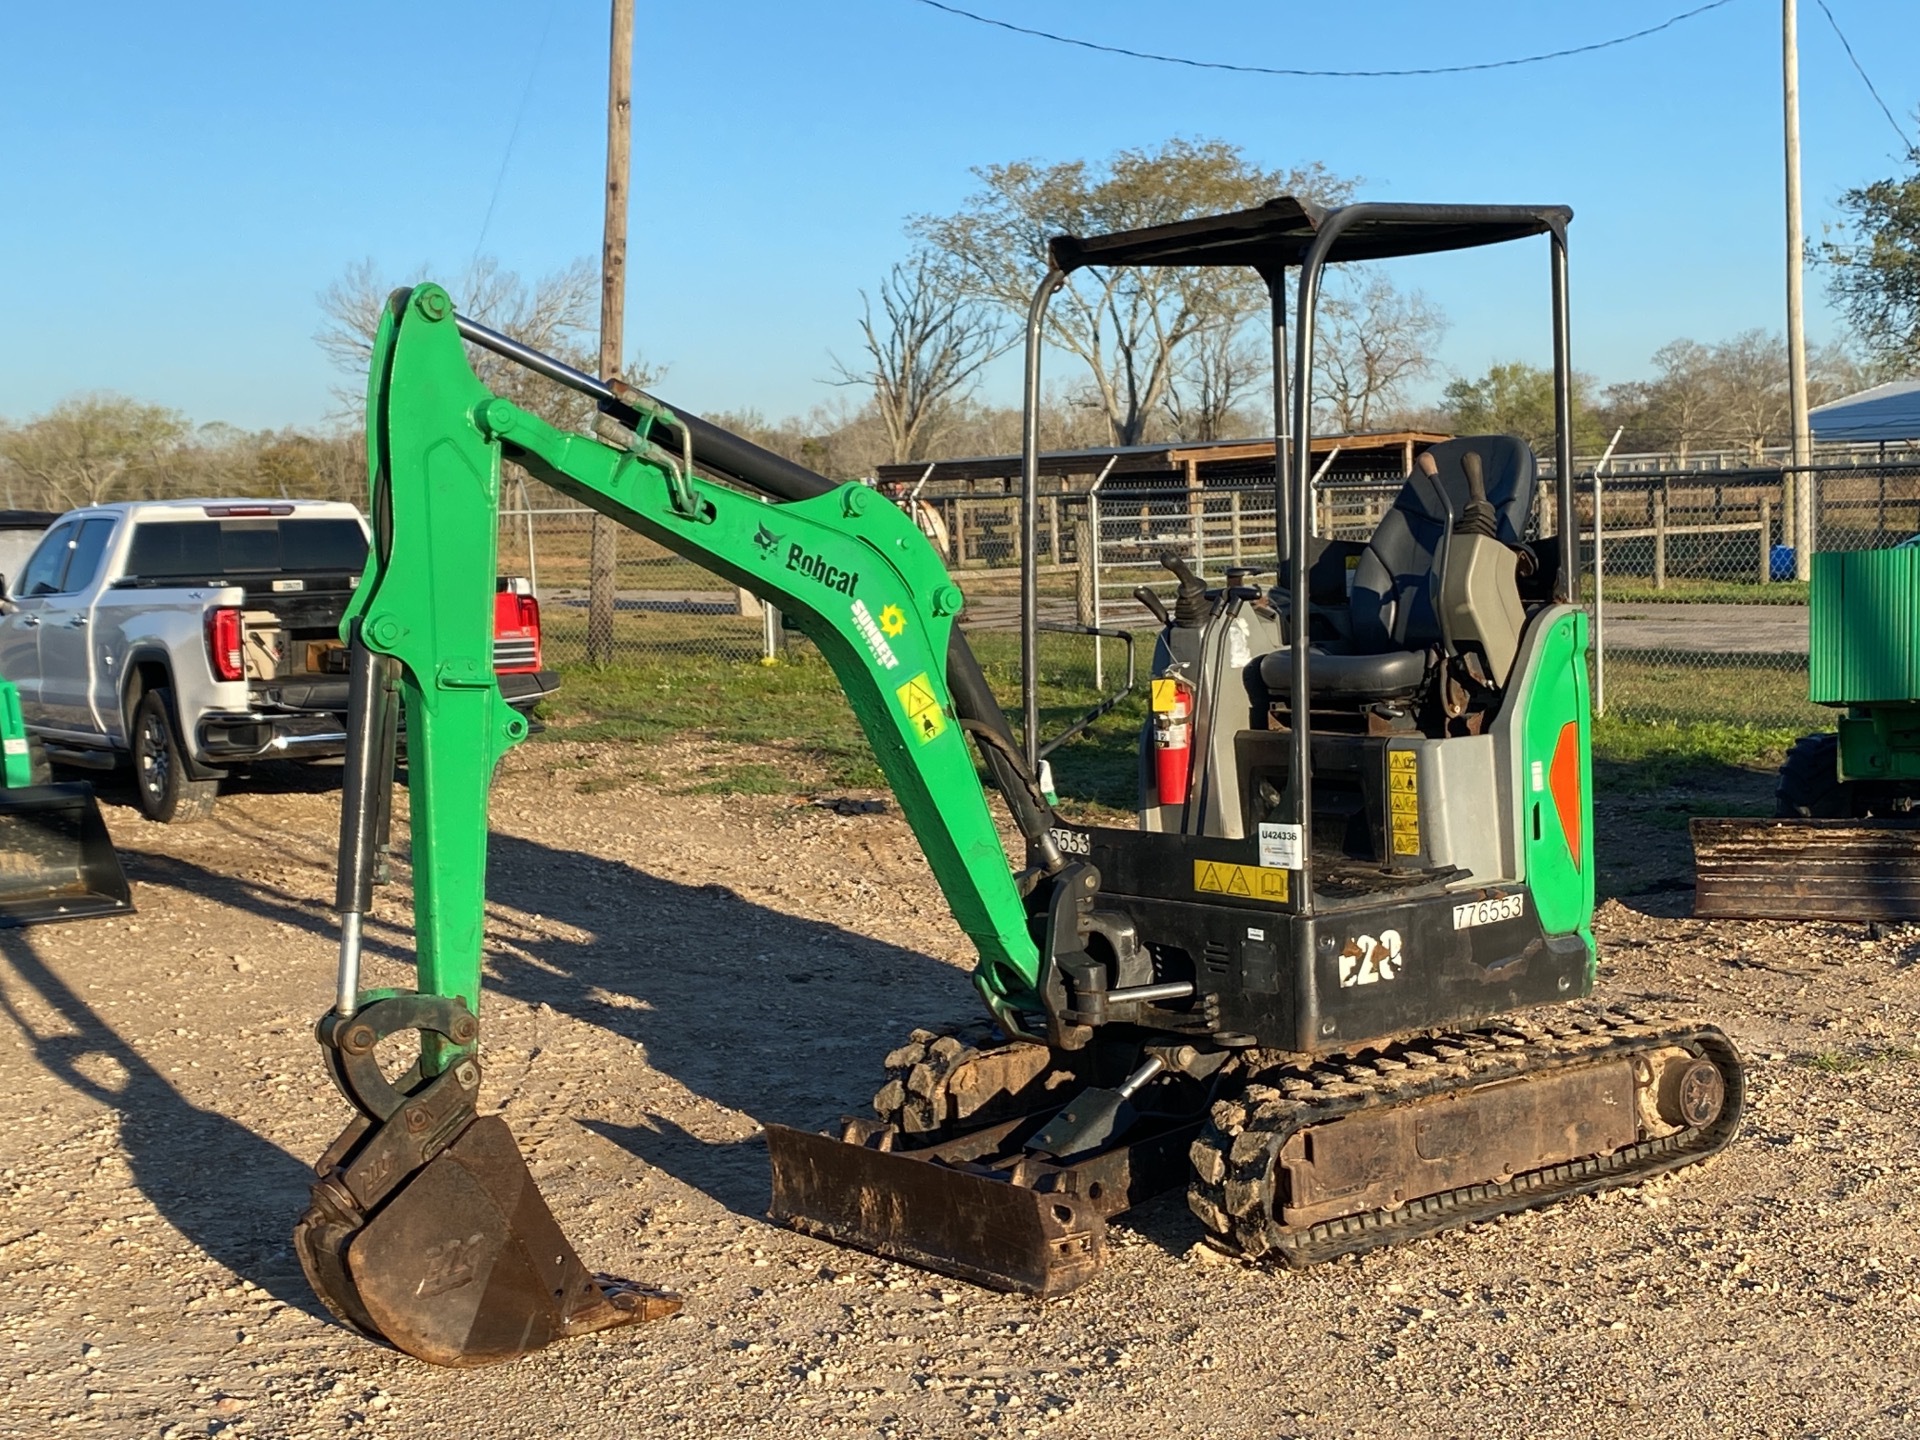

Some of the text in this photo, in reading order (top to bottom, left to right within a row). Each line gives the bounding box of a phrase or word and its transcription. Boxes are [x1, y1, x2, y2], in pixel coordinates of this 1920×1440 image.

[786, 543, 858, 598] Bobcat
[851, 599, 899, 670] SUNBELT
[1455, 896, 1521, 928] 776553
